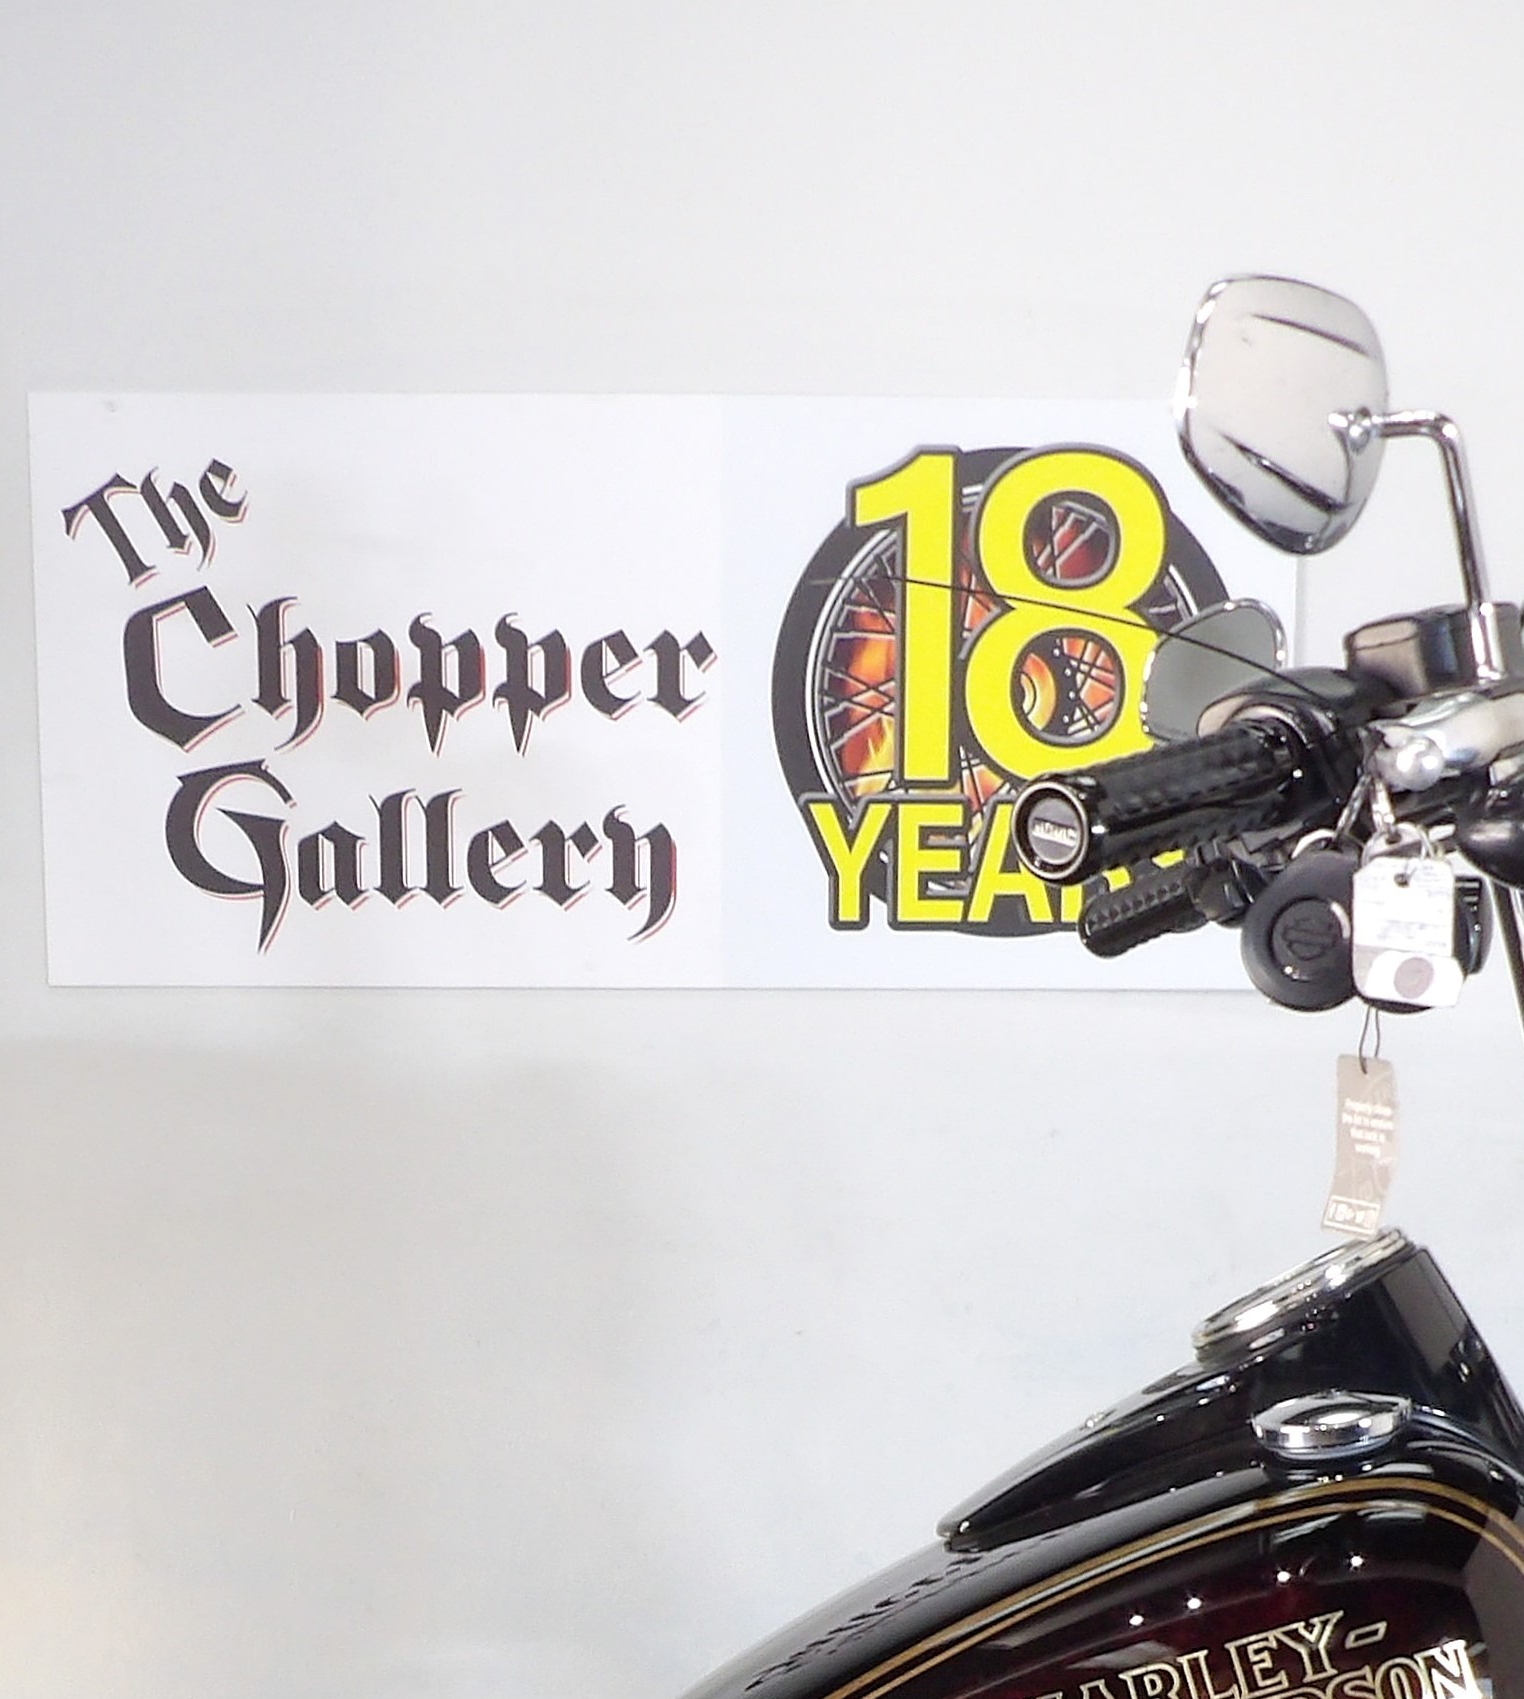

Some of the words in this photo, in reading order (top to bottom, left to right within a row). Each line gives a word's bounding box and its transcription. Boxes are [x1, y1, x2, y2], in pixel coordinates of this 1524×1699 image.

[61, 457, 249, 588] The
[122, 585, 718, 754] Chopper
[855, 450, 1167, 783] 18
[164, 757, 681, 952] Gallery
[810, 801, 1186, 922] YEA
